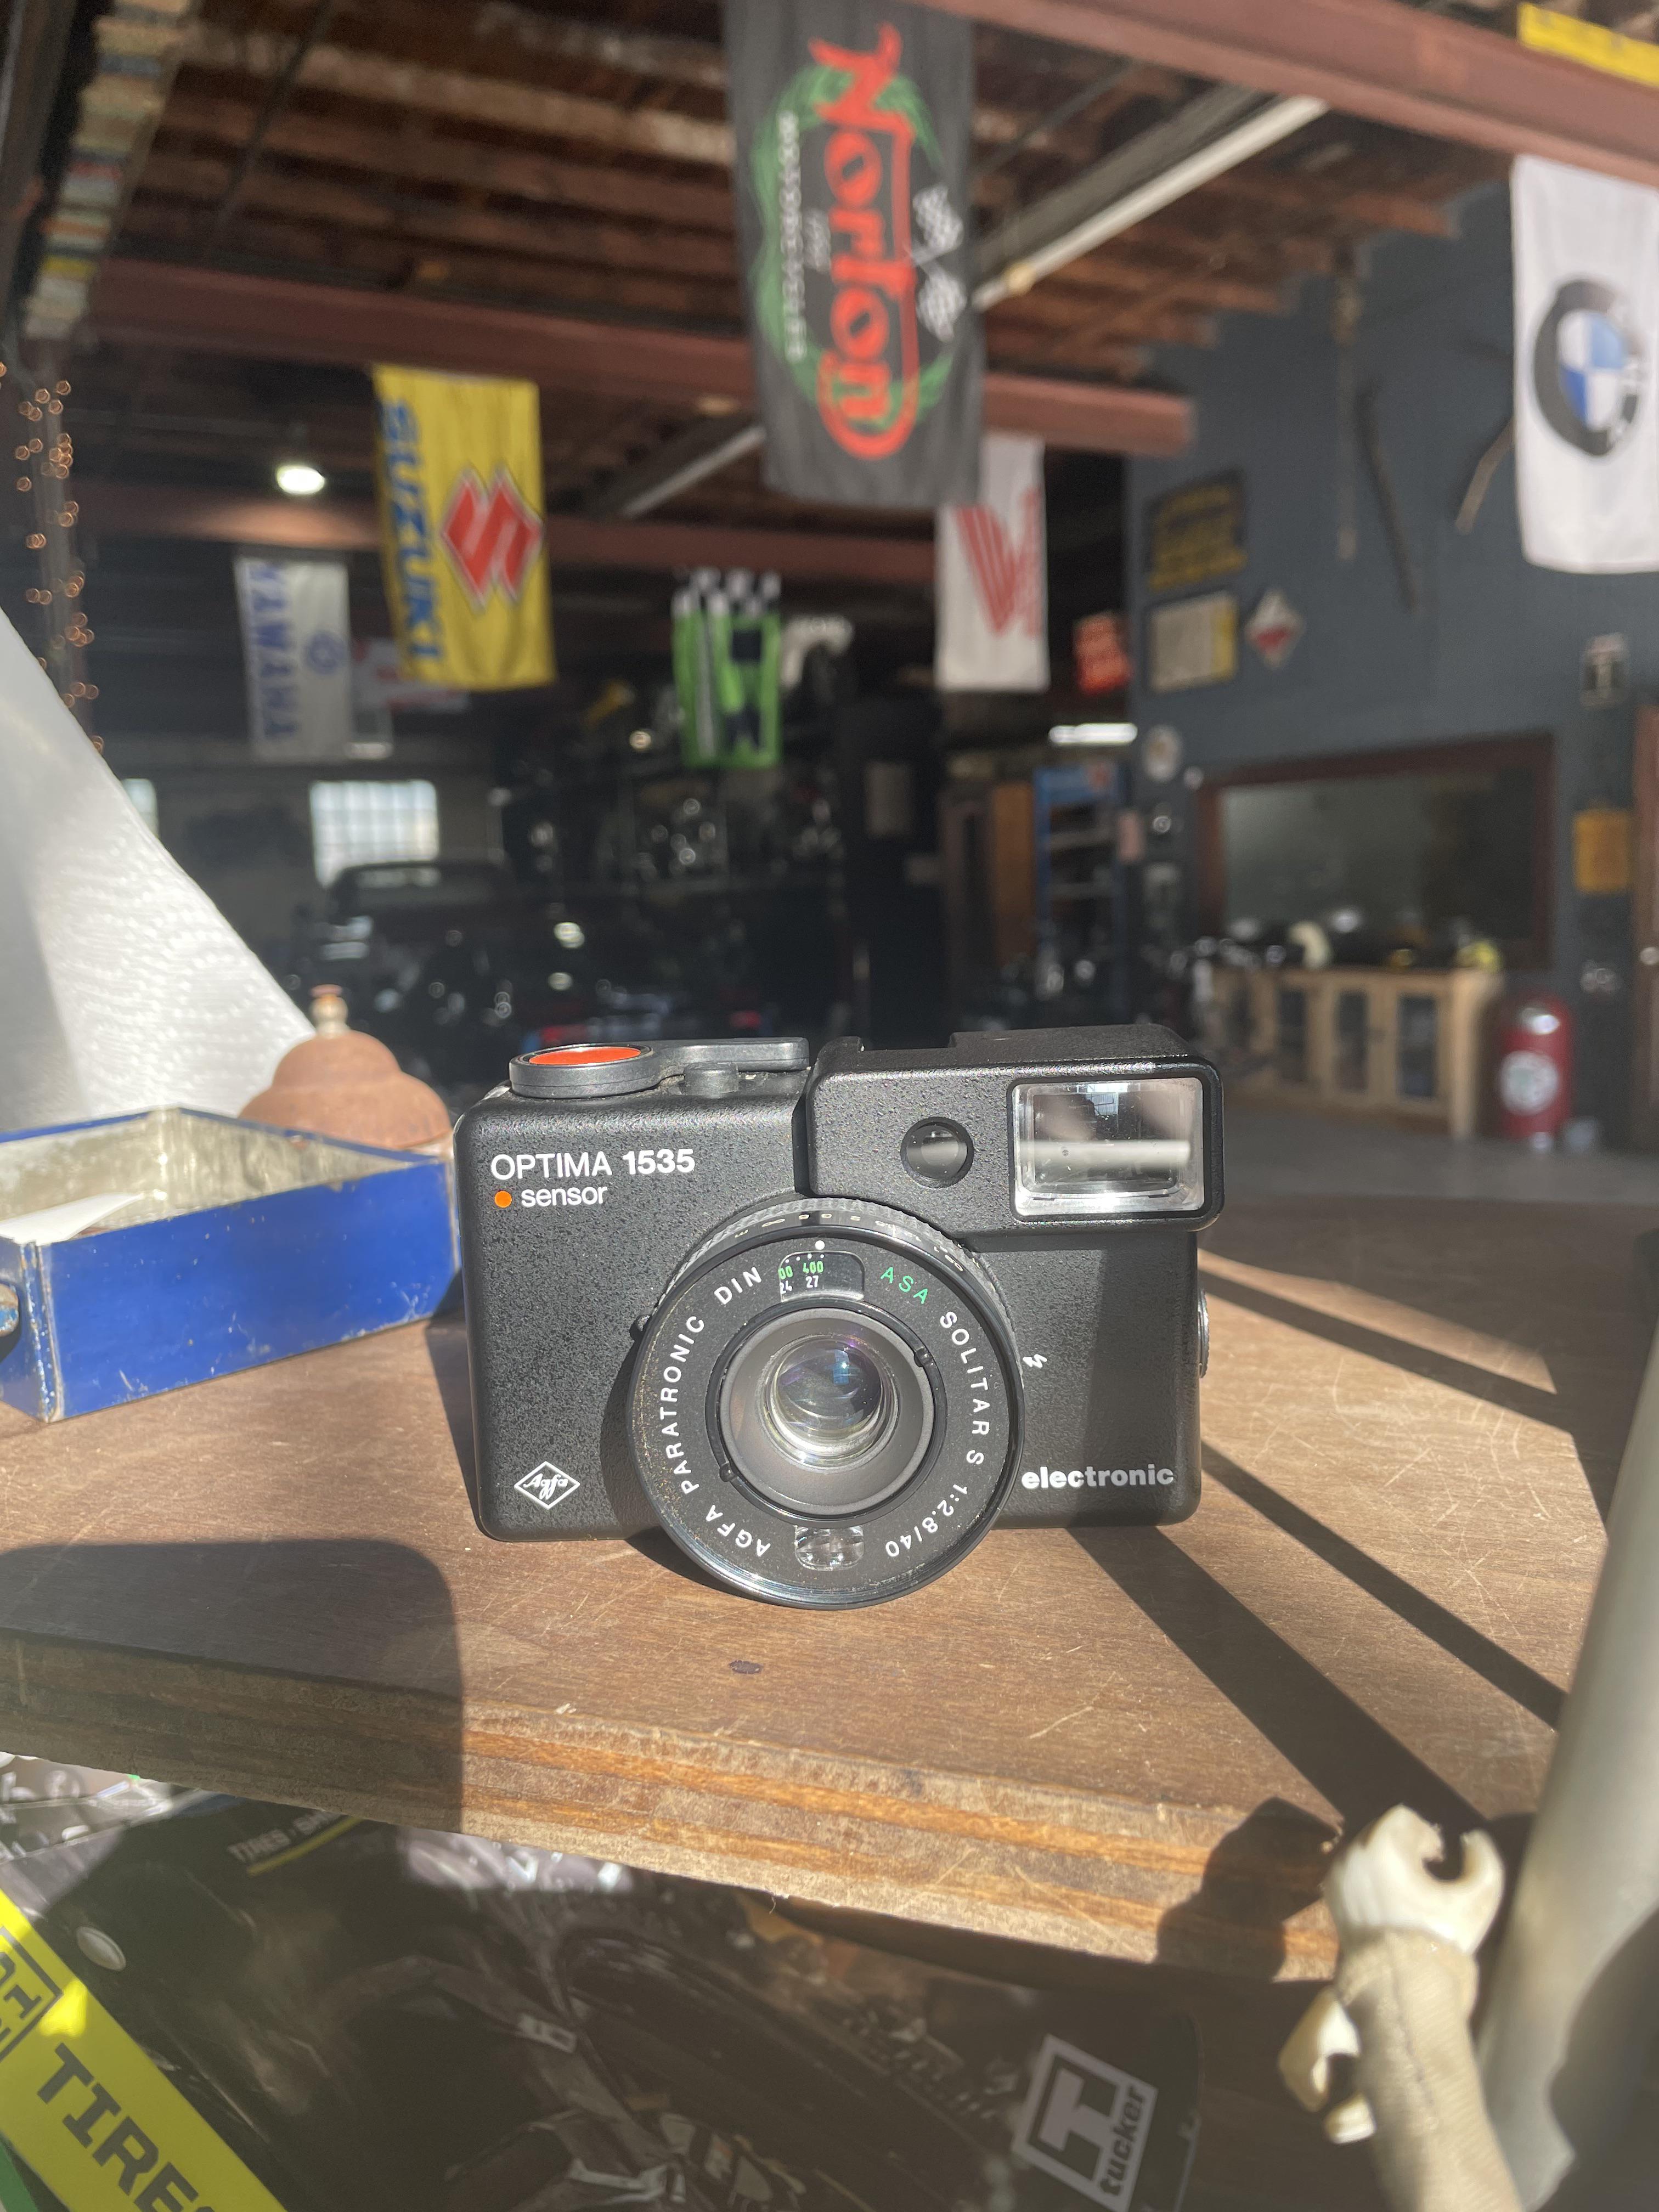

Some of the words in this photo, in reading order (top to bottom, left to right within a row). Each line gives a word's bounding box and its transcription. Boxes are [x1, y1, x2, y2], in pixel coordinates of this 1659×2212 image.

[808, 21, 919, 460] Norton
[383, 398, 441, 658] SUZUKI
[490, 1150, 613, 1181] OPTIMA
[623, 1148, 696, 1176] 1535
[521, 1186, 608, 1207] sensor
[714, 1266, 762, 1305] DIN
[777, 1265, 793, 1280] 00
[803, 1260, 824, 1274] 400
[779, 1280, 793, 1294] 24
[805, 1275, 820, 1288] 27
[881, 1266, 928, 1305] ASA
[940, 1311, 990, 1436] SOLITAR
[660, 1316, 705, 1494] PARATRONIC
[966, 1449, 984, 1465] S
[1022, 1463, 1174, 1489] electronic
[523, 1472, 568, 1500] Agfa
[706, 1504, 771, 1557] AGFA
[885, 1483, 968, 1558] 1:2.8/40
[36, 2042, 218, 2212] TIRE
[1099, 2084, 1146, 2197] tucker
